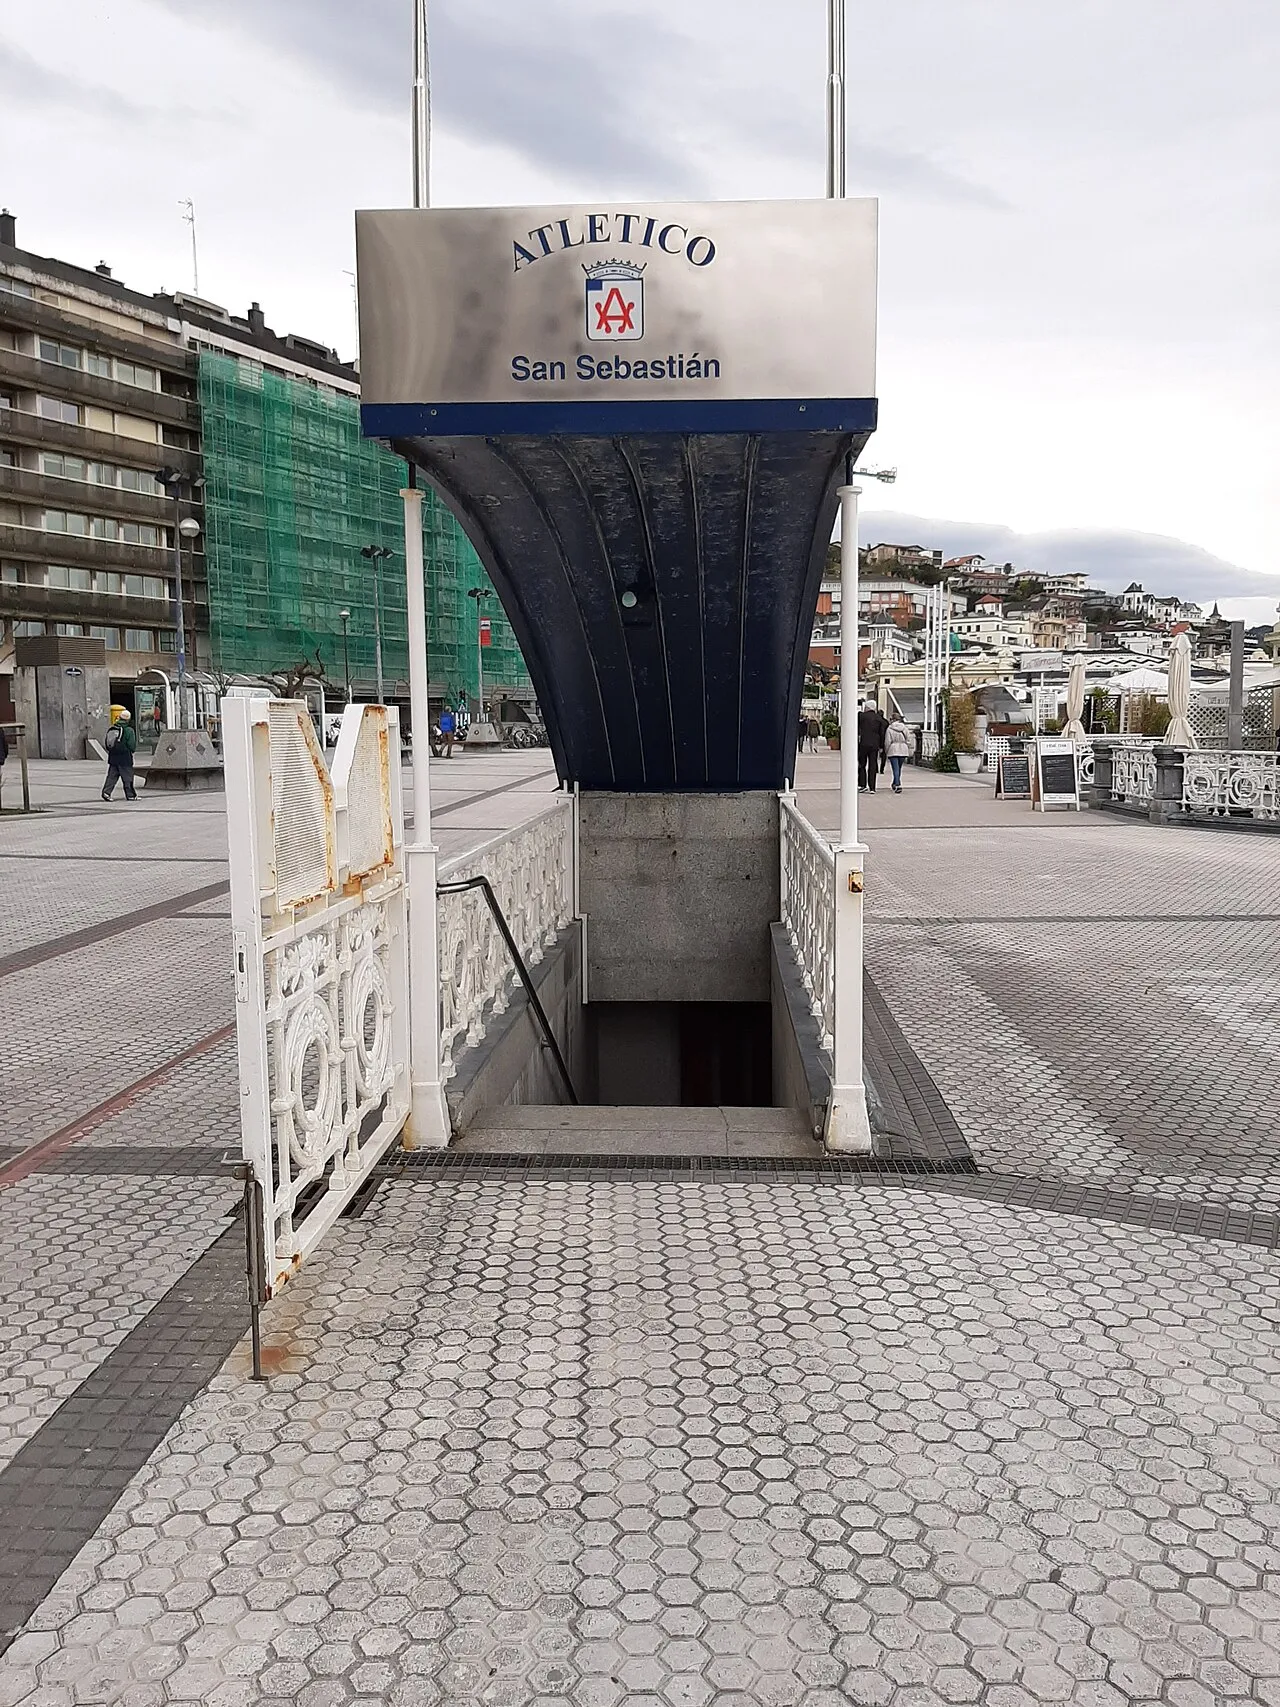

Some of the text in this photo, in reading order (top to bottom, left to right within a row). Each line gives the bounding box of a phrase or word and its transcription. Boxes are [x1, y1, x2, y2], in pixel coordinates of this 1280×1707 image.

[512, 213, 716, 273] ATLETICO
[511, 352, 720, 381] San Sebastián
